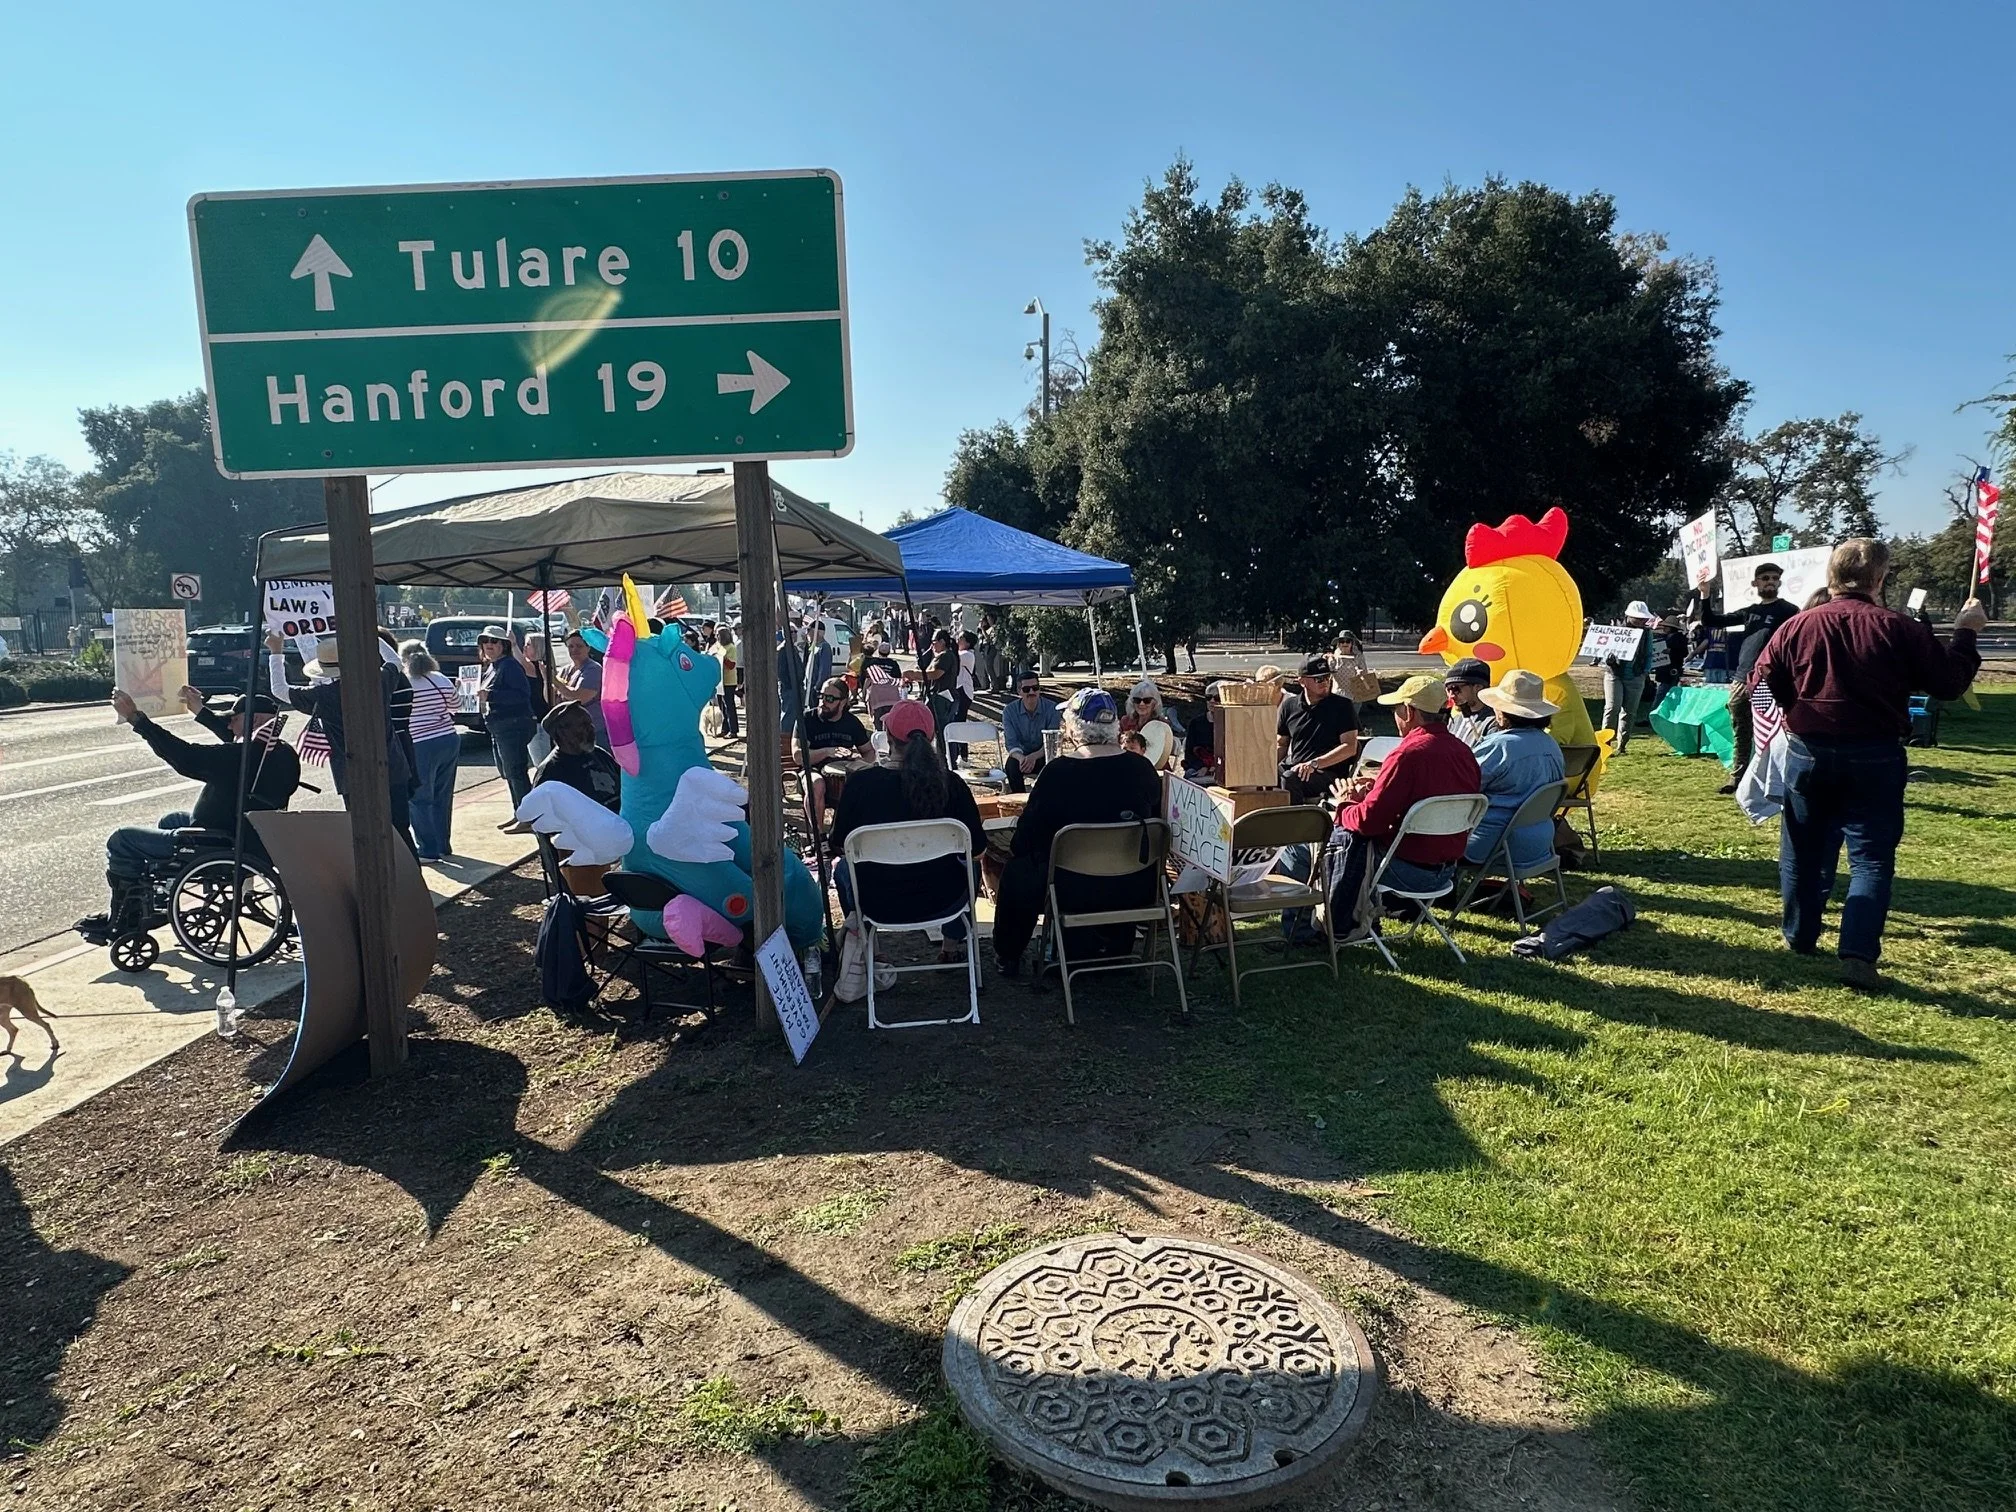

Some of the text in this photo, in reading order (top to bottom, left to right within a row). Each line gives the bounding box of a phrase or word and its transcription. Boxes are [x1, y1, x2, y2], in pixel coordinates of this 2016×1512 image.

[398, 229, 750, 291] Tulare 10
[265, 360, 667, 426] Hanford 19
[1693, 521, 1703, 536] NO
[1698, 550, 1707, 565] NO
[269, 596, 320, 615] LAW &
[282, 615, 337, 637] ORDE
[1589, 626, 1633, 637] HEALTHCARE
[1614, 636, 1637, 644] over
[1583, 647, 1599, 655] TAX
[1171, 779, 1223, 825] WALK
[1189, 815, 1205, 836] IN
[1170, 822, 1225, 875] PEACE
[1232, 847, 1278, 866] NGS
[769, 953, 806, 1039] GOVERNMENT
[771, 982, 794, 1030] MAKE
